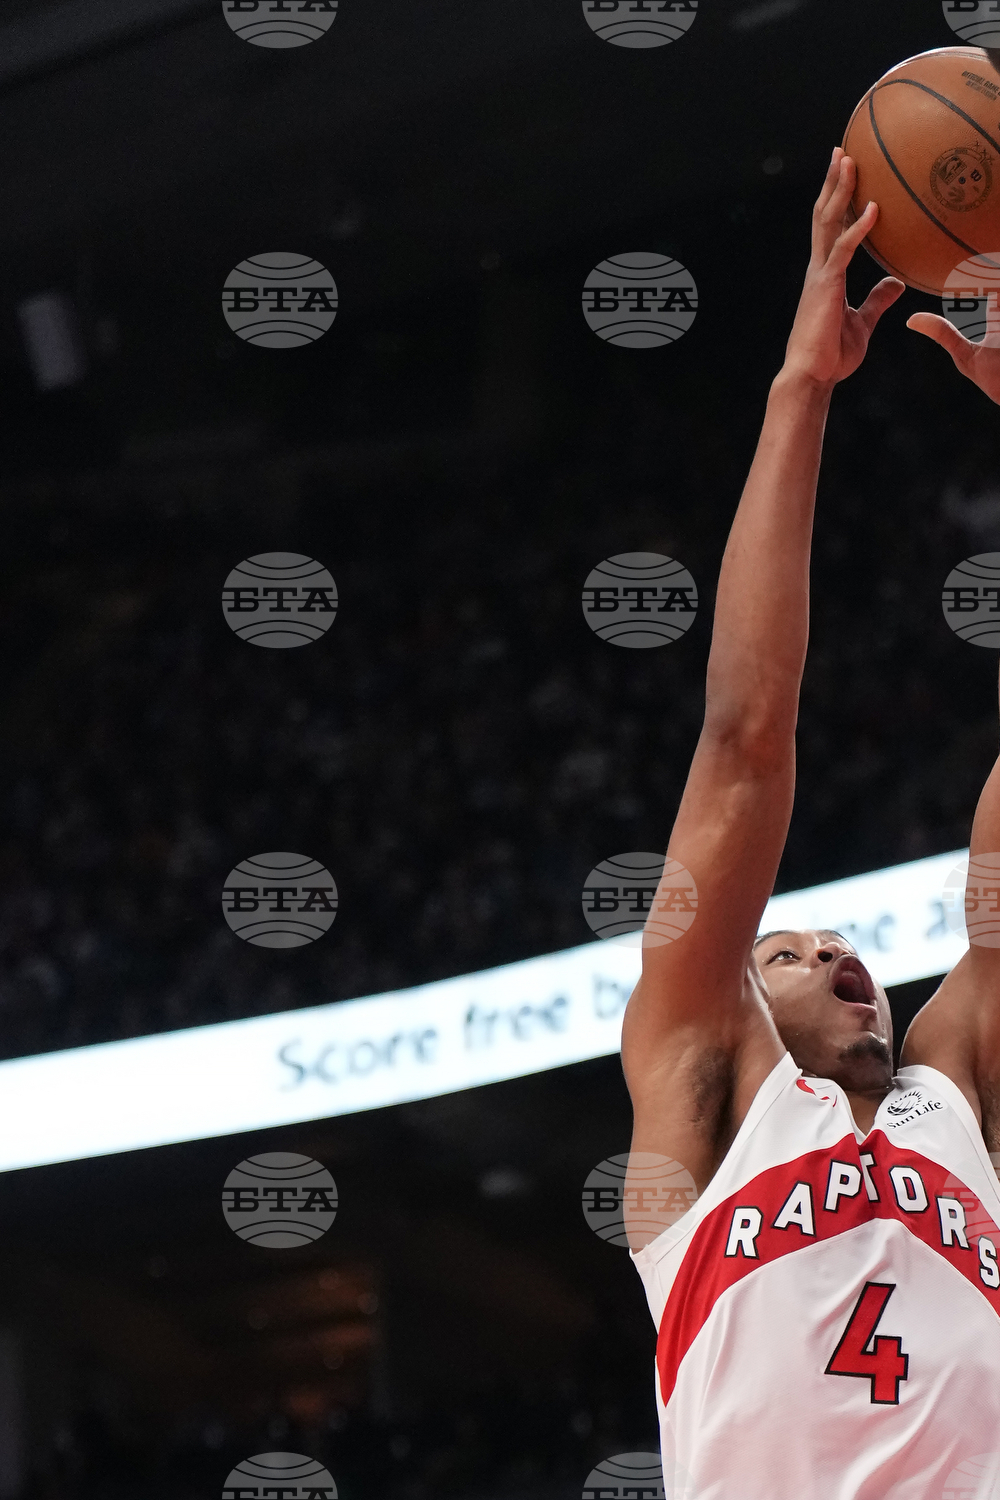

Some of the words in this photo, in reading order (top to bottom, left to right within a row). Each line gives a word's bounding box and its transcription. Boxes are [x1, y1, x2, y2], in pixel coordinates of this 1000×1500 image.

[276, 1027, 439, 1093] Score
[464, 991, 569, 1051] free
[886, 1114, 915, 1130] Sun
[915, 1100, 943, 1116] Life
[724, 1151, 1000, 1290] RAPTORS
[824, 1281, 909, 1405] 4
